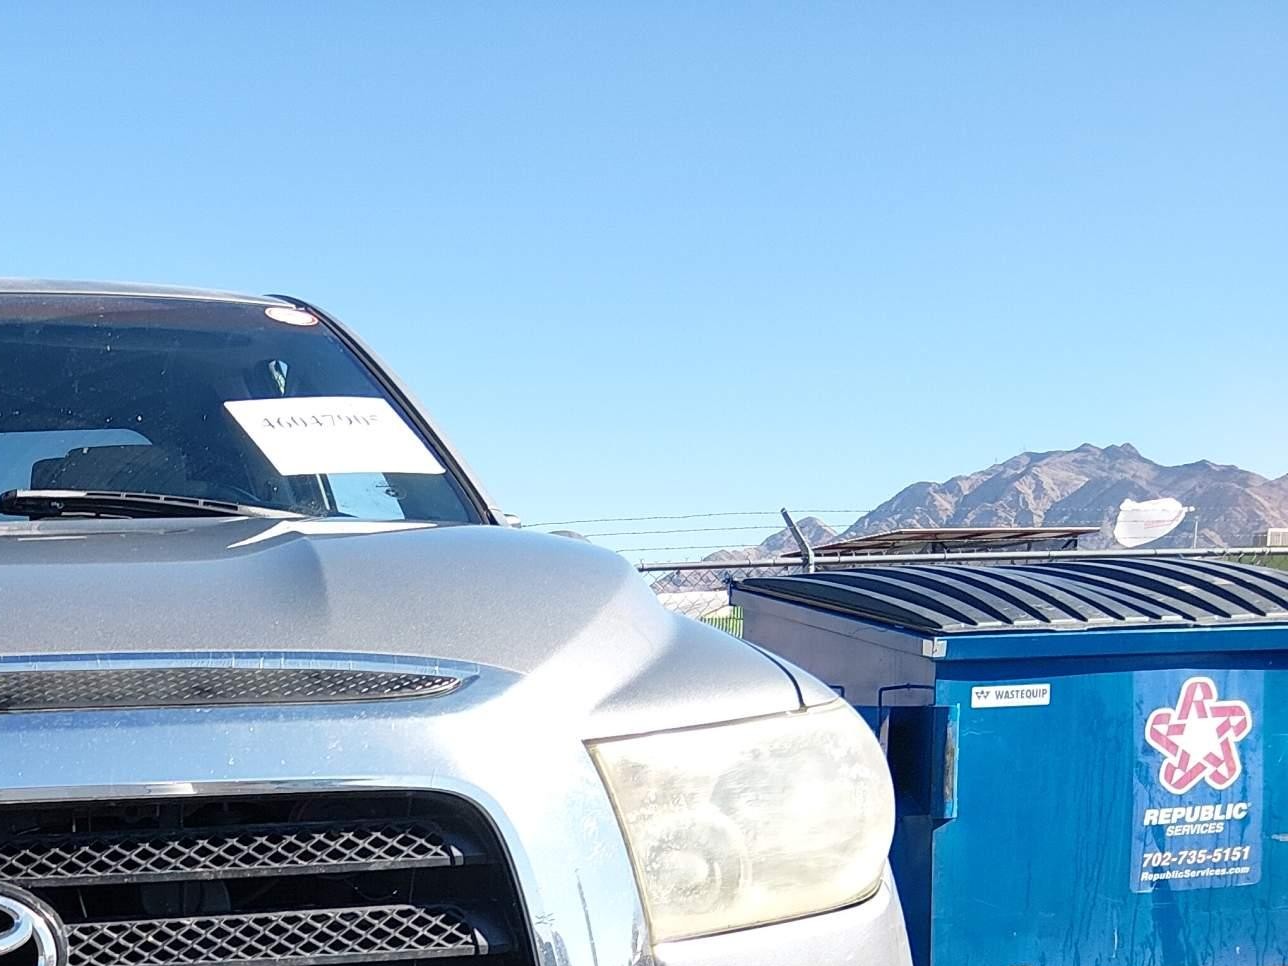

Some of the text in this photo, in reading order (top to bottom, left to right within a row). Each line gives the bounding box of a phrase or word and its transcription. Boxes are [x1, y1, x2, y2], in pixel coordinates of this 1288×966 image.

[995, 688, 1048, 700] WASTEQUIP
[1143, 802, 1249, 826] REPUBLIC
[1166, 822, 1225, 837] SERVICES
[1142, 846, 1251, 868] 702-735-5151
[1140, 866, 1251, 882] RepublicServices.com
